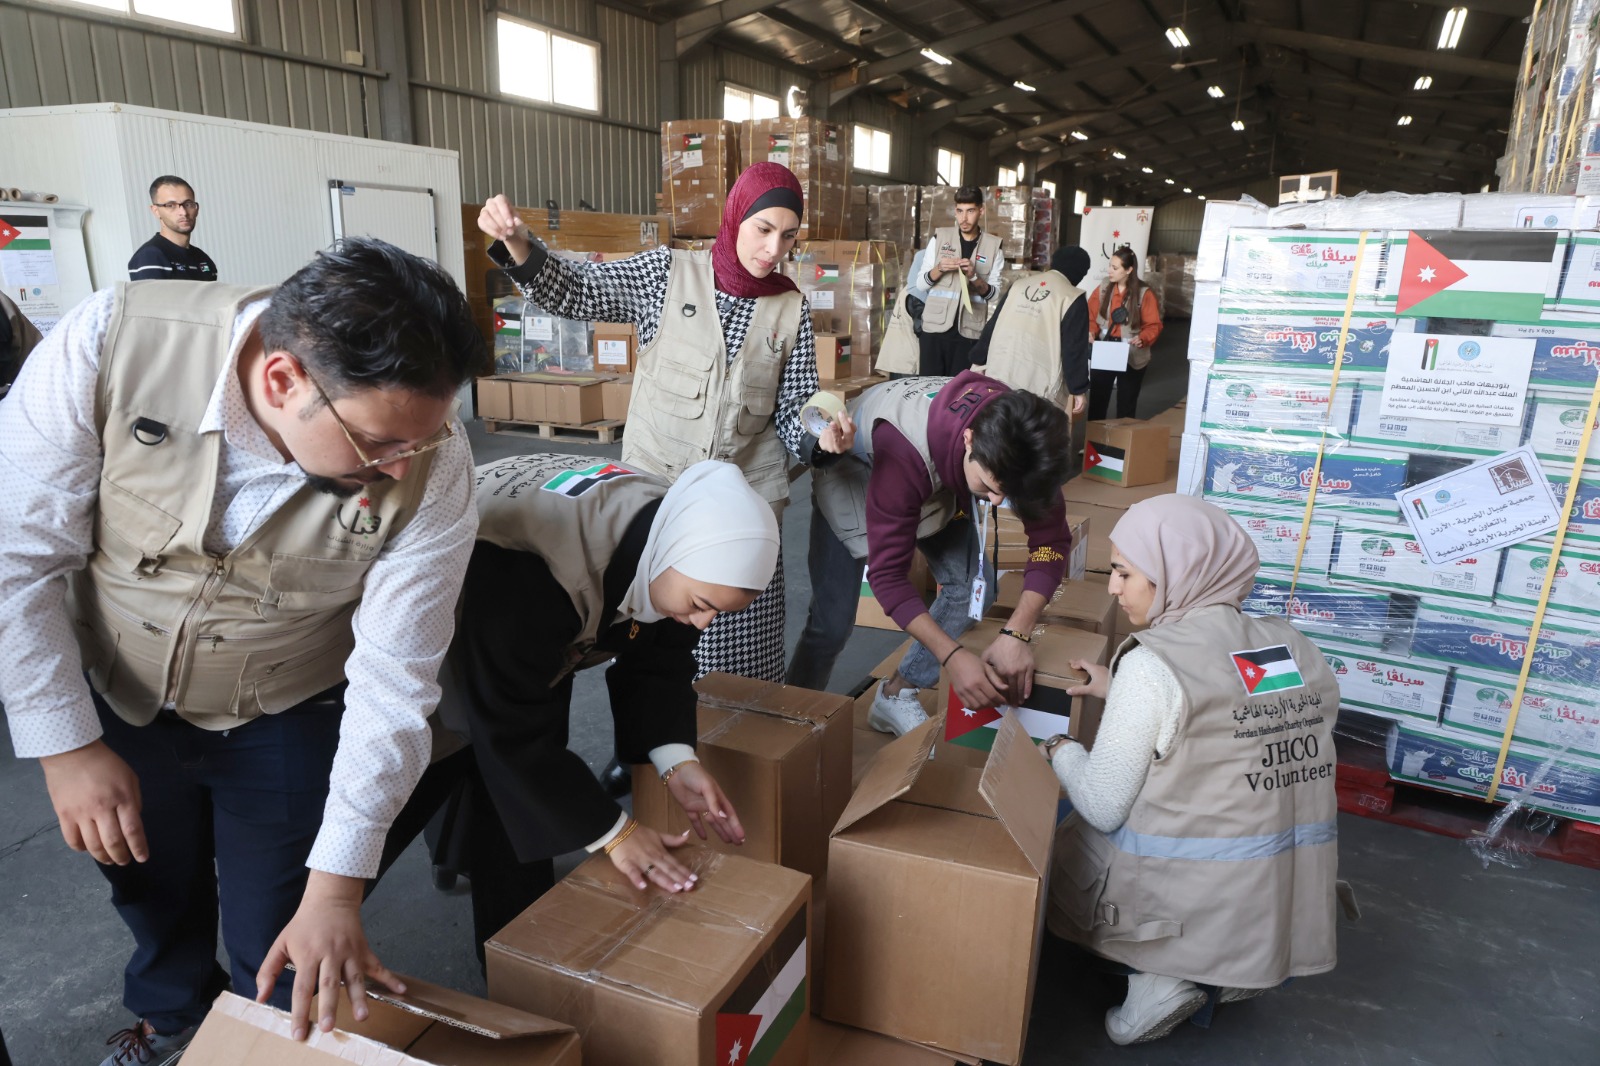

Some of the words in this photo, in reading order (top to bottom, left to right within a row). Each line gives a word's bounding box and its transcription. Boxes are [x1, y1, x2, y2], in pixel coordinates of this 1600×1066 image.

[640, 221, 659, 246] CAT
[1401, 376, 1433, 384] الهاشمية
[1508, 494, 1535, 506] جمعية
[1487, 503, 1508, 516] عيبال
[1455, 510, 1485, 525] الخيرية
[1478, 516, 1507, 532] بالتعاون
[1430, 522, 1451, 536] الأردن
[1467, 527, 1477, 536] مع
[1496, 523, 1527, 538] الخيرية
[1435, 543, 1467, 557] الهاشمية
[1234, 729, 1259, 739] Jordan
[1258, 723, 1285, 736] Hashemite
[1262, 734, 1318, 768] JHCO
[1244, 763, 1333, 792] Volunteer
